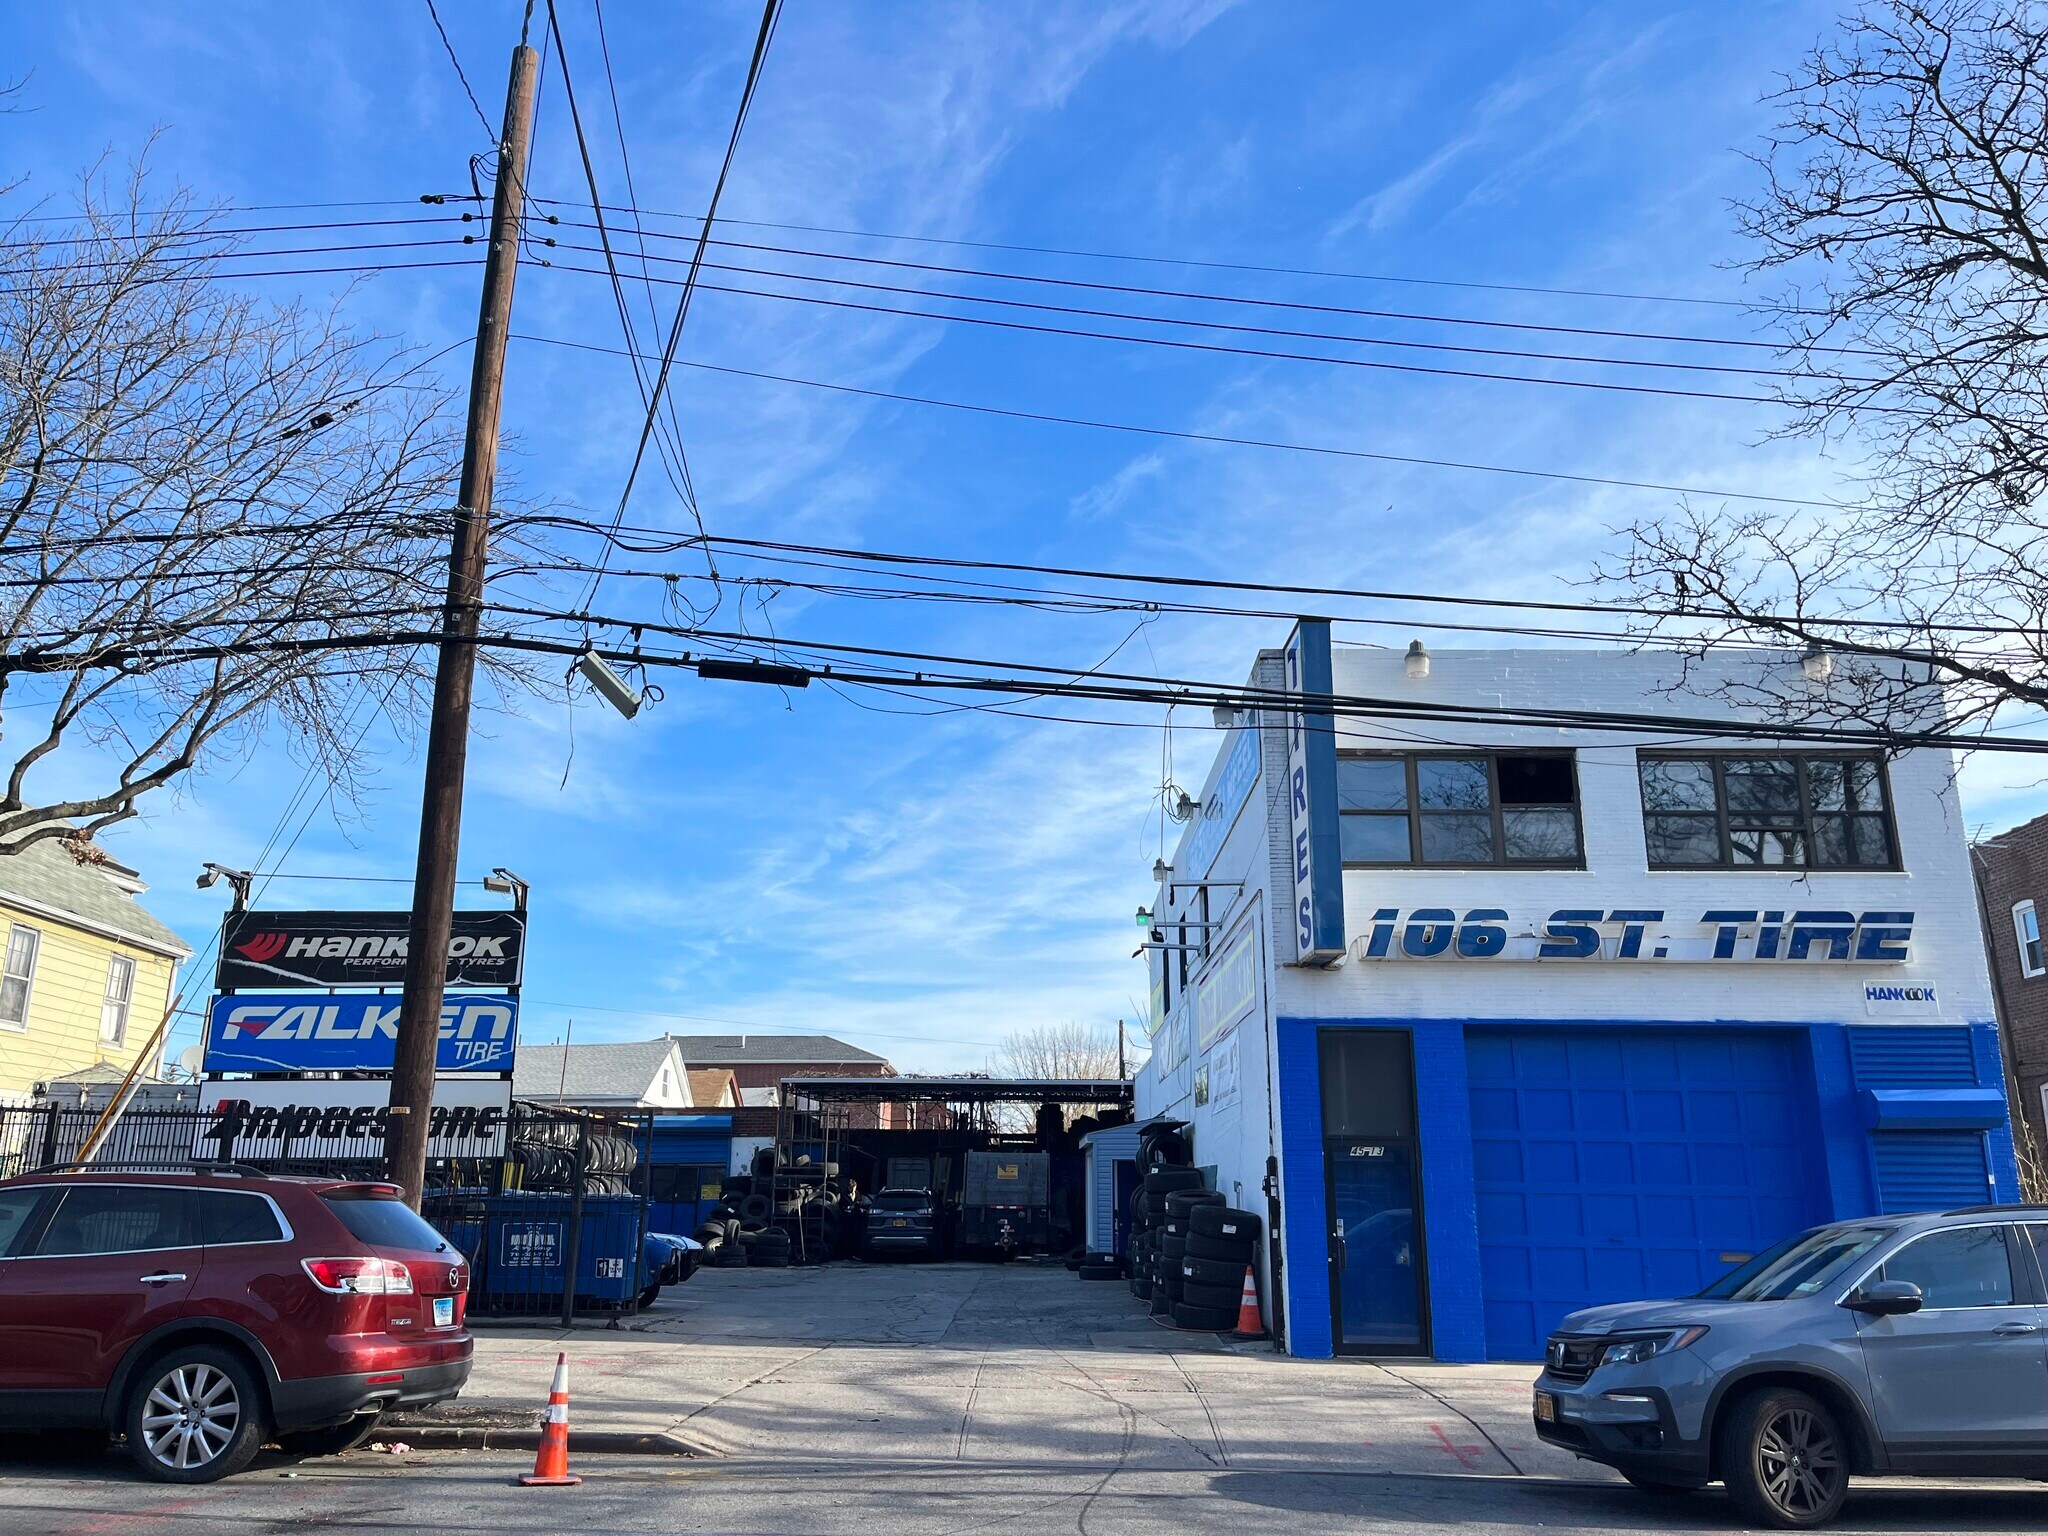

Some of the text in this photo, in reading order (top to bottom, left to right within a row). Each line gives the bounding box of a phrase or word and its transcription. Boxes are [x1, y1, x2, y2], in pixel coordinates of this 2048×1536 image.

[1287, 647, 1311, 949] TIRES
[1366, 908, 1915, 959] 106 ST. TIRE
[459, 957, 505, 966] TYRES
[1865, 986, 1936, 1001] HANKOOK
[454, 1041, 504, 1060] TIRE
